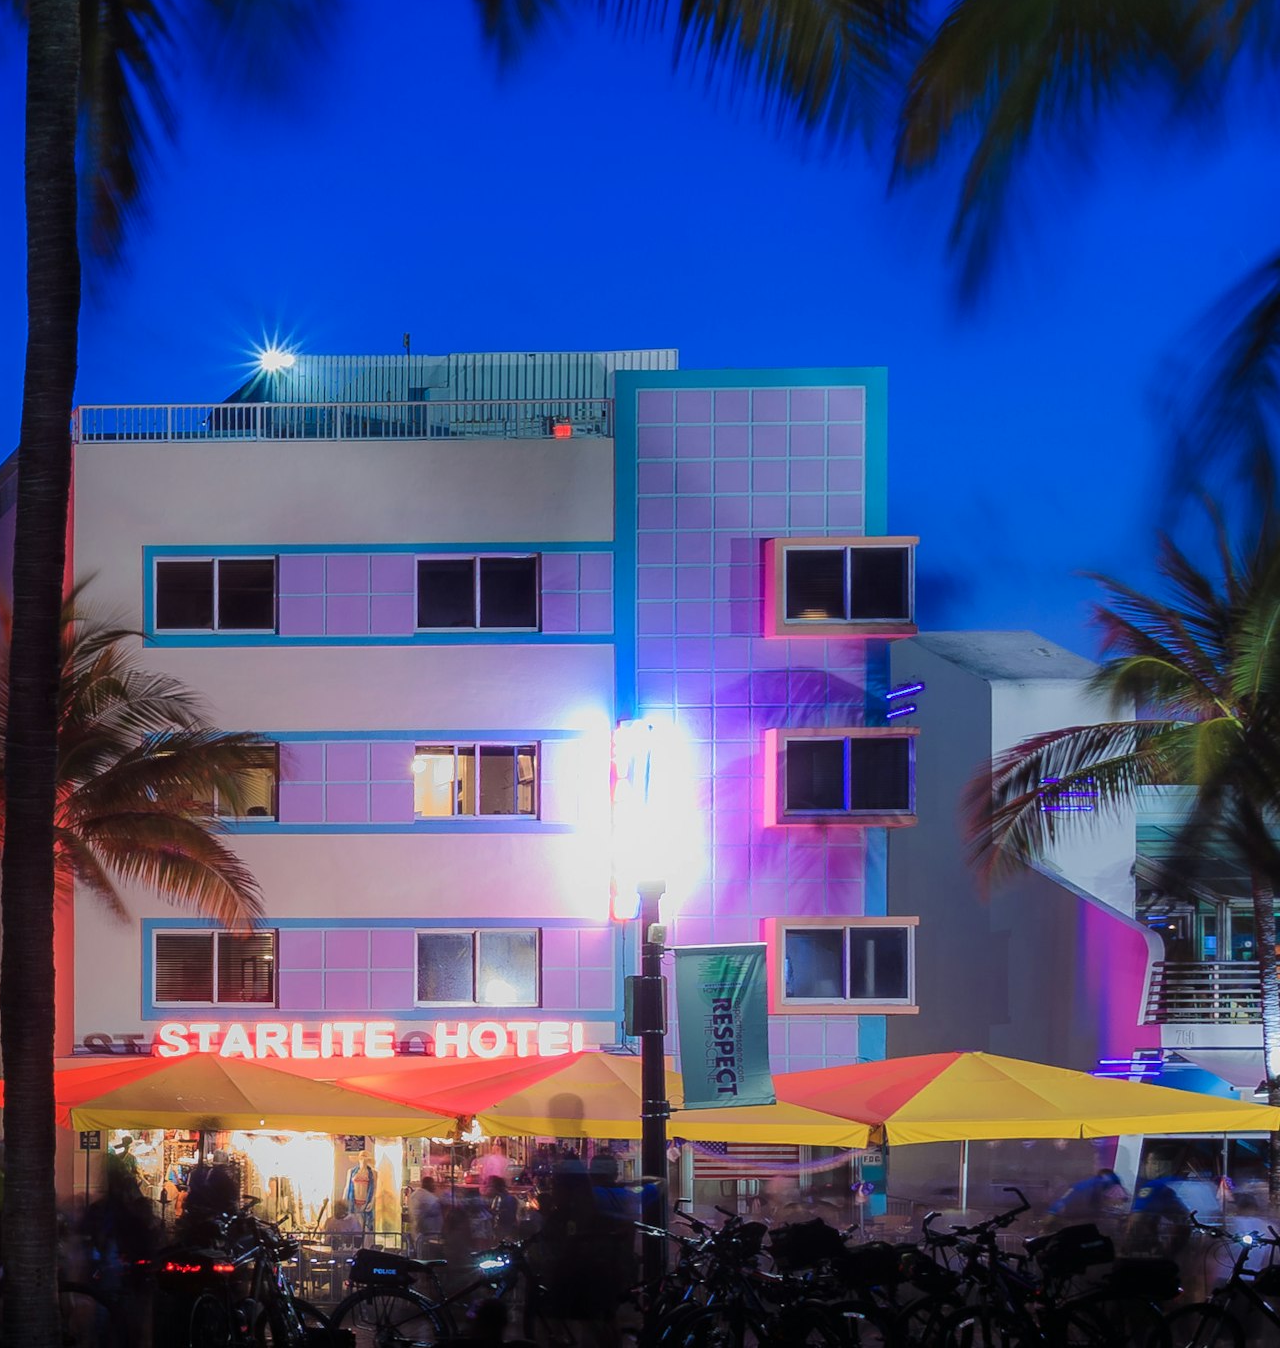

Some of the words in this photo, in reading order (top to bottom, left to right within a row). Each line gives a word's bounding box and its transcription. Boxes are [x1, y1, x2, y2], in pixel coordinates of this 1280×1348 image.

[158, 1022, 396, 1059] STARLITE
[704, 1014, 714, 1035] THE
[705, 1040, 718, 1084] SCENE
[712, 997, 738, 1096] RESPECT
[373, 1267, 397, 1275] POLICE
